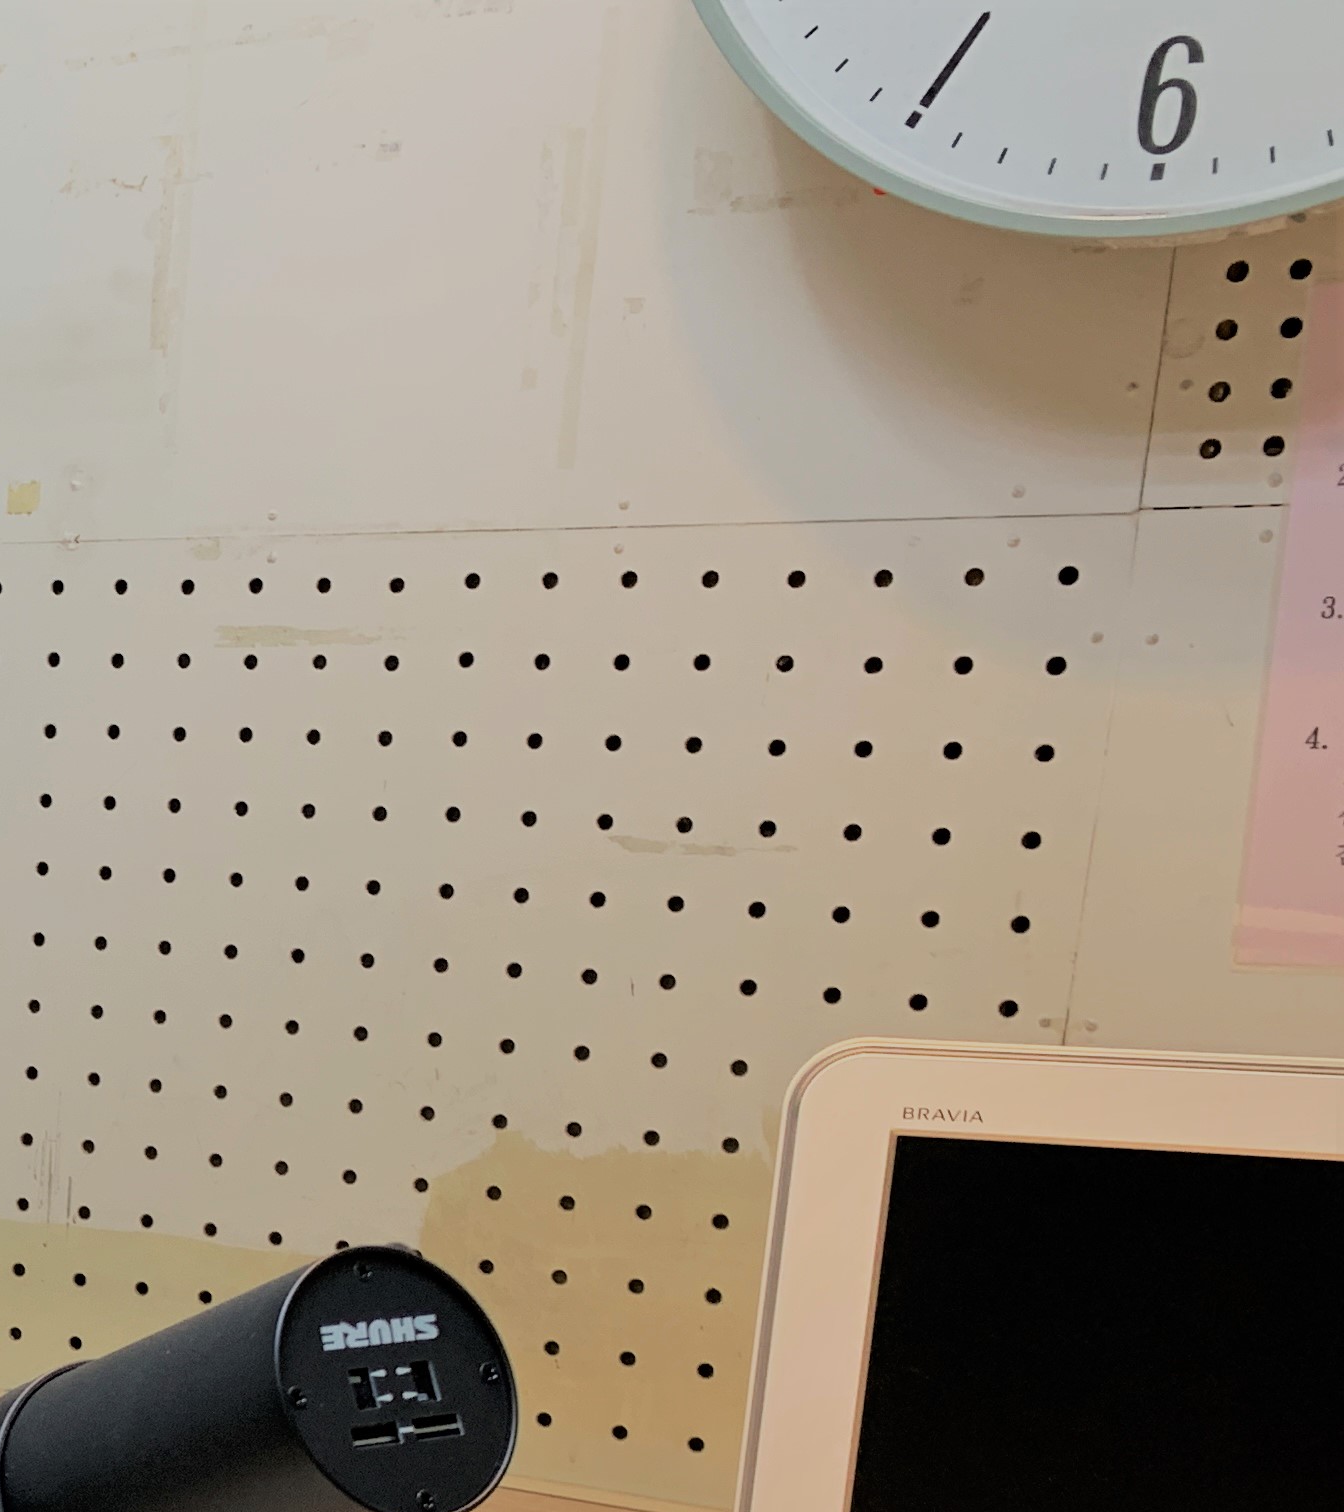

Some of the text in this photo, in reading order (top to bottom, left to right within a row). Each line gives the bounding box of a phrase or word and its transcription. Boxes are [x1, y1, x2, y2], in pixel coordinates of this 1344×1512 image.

[1138, 35, 1204, 155] 6
[1320, 595, 1344, 620] 3.
[1304, 725, 1329, 750] 4.
[902, 1106, 984, 1124] BRAVIA
[319, 1313, 440, 1352] SHURE
